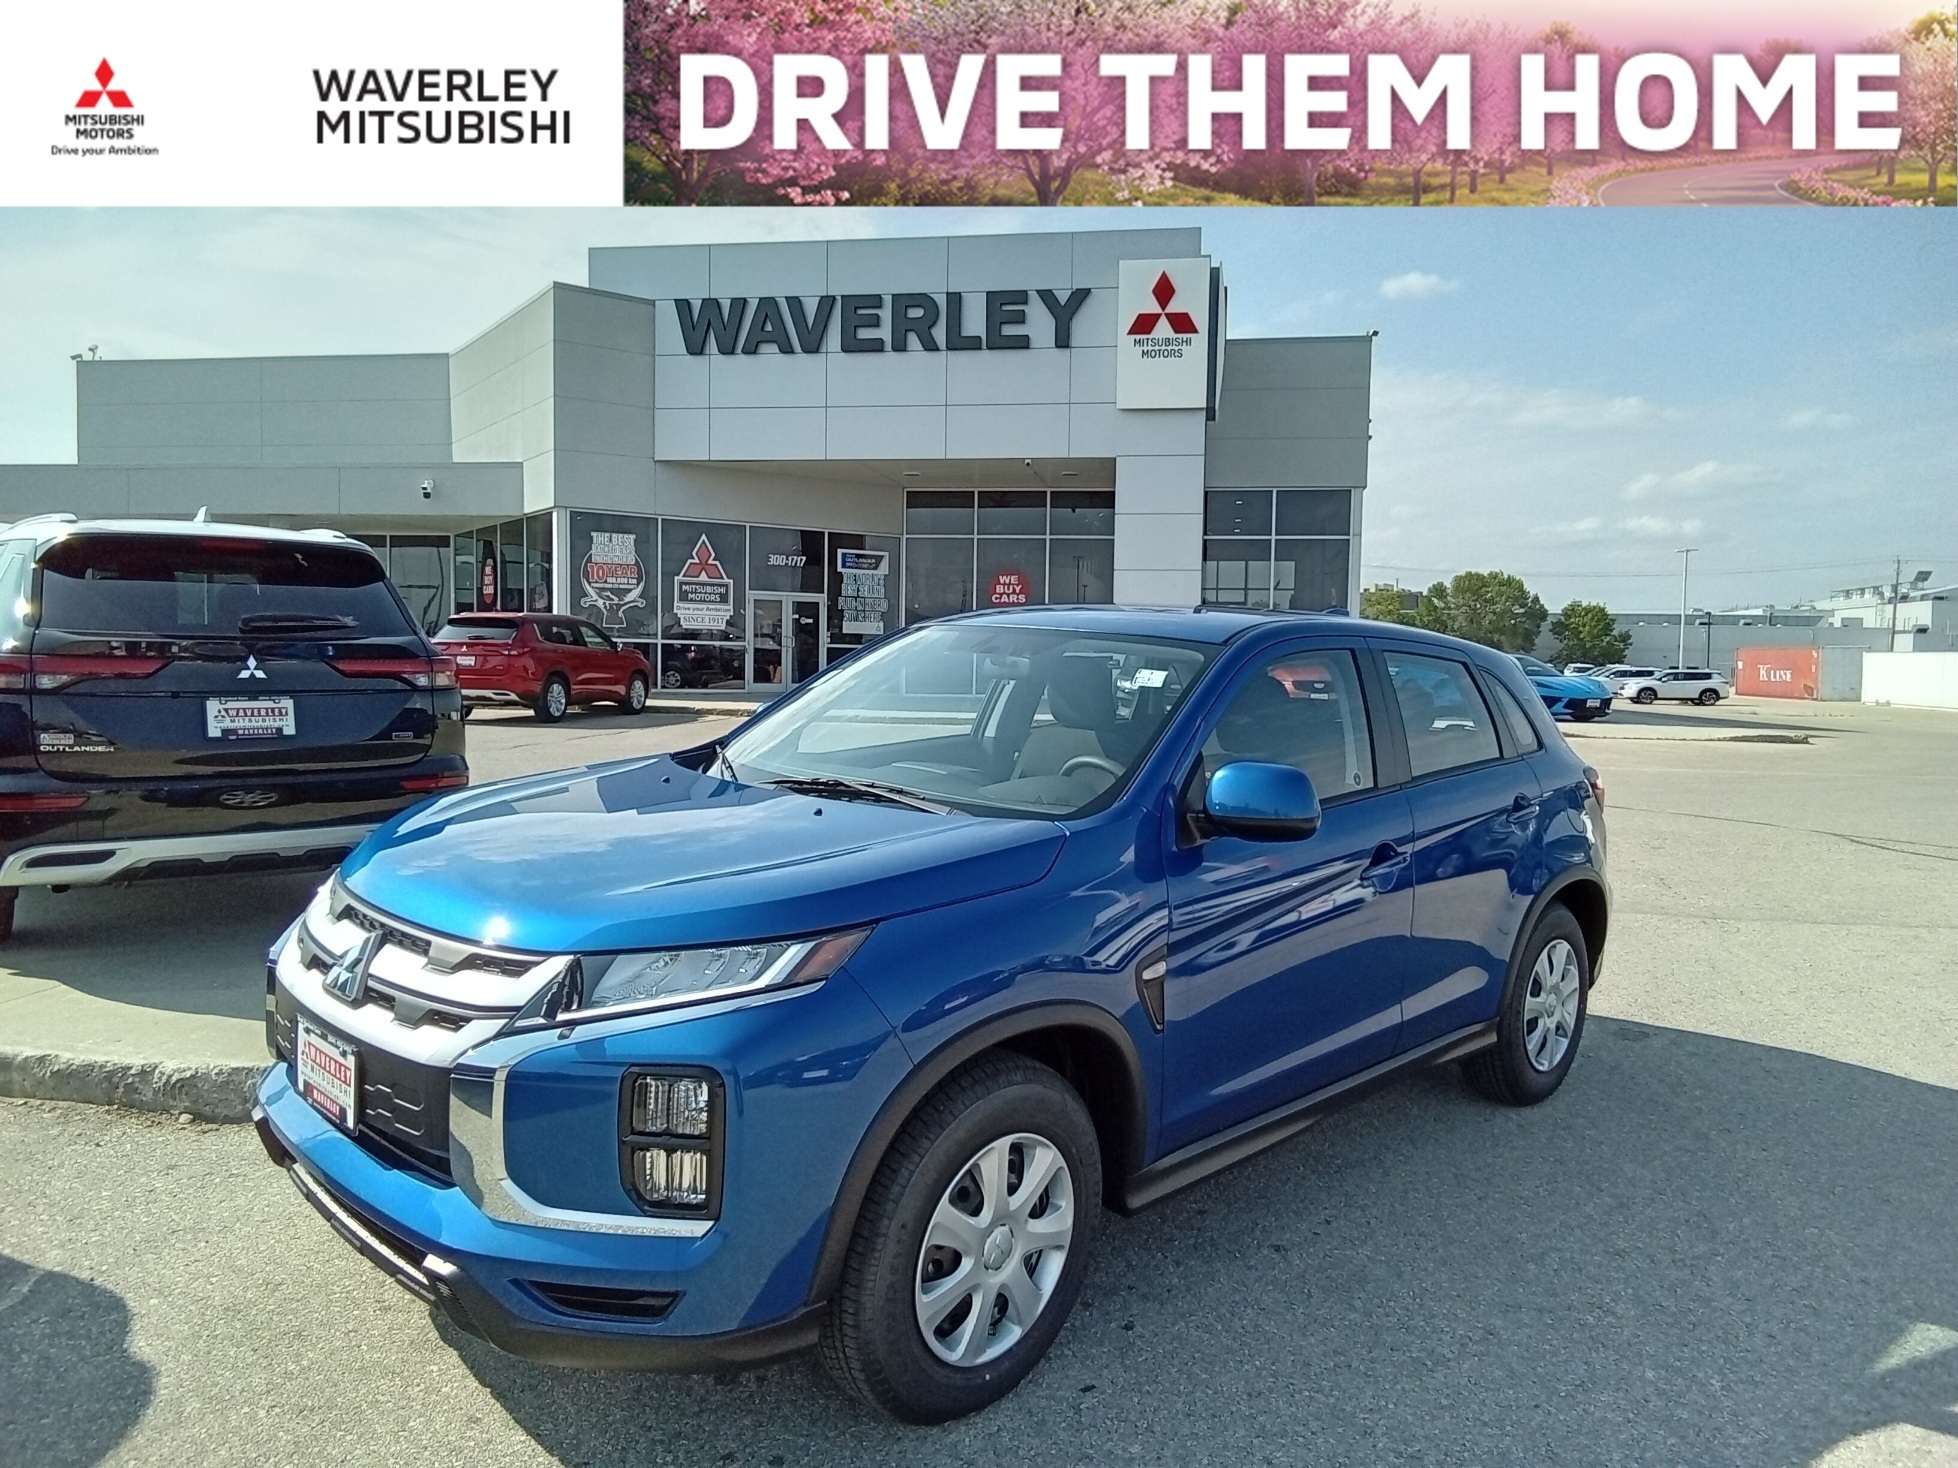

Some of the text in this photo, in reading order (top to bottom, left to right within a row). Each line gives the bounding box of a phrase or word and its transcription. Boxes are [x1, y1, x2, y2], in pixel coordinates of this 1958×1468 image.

[673, 288, 1092, 355] WAVERLEY
[1133, 337, 1192, 348] MITSUBISHI
[1141, 348, 1184, 359] MOTORS
[591, 531, 636, 546] THE BEST
[767, 554, 807, 567] 300-1717
[588, 563, 638, 582] 10 YEAR
[999, 575, 1019, 584] WE
[682, 584, 726, 594] MITSUBISHI
[842, 584, 885, 598] BEST SELLING
[995, 584, 1022, 593] BUY
[688, 593, 720, 602] MOTORS
[991, 594, 1026, 603] CARS
[683, 616, 724, 625] SINCE 1917
[1757, 664, 1792, 682] K LINE
[228, 708, 287, 717] WAVERLEY
[309, 1042, 351, 1085] WAVERLEY
[310, 1064, 351, 1100] MITSUBISHI
[313, 1087, 340, 1116] WAVERLEY
